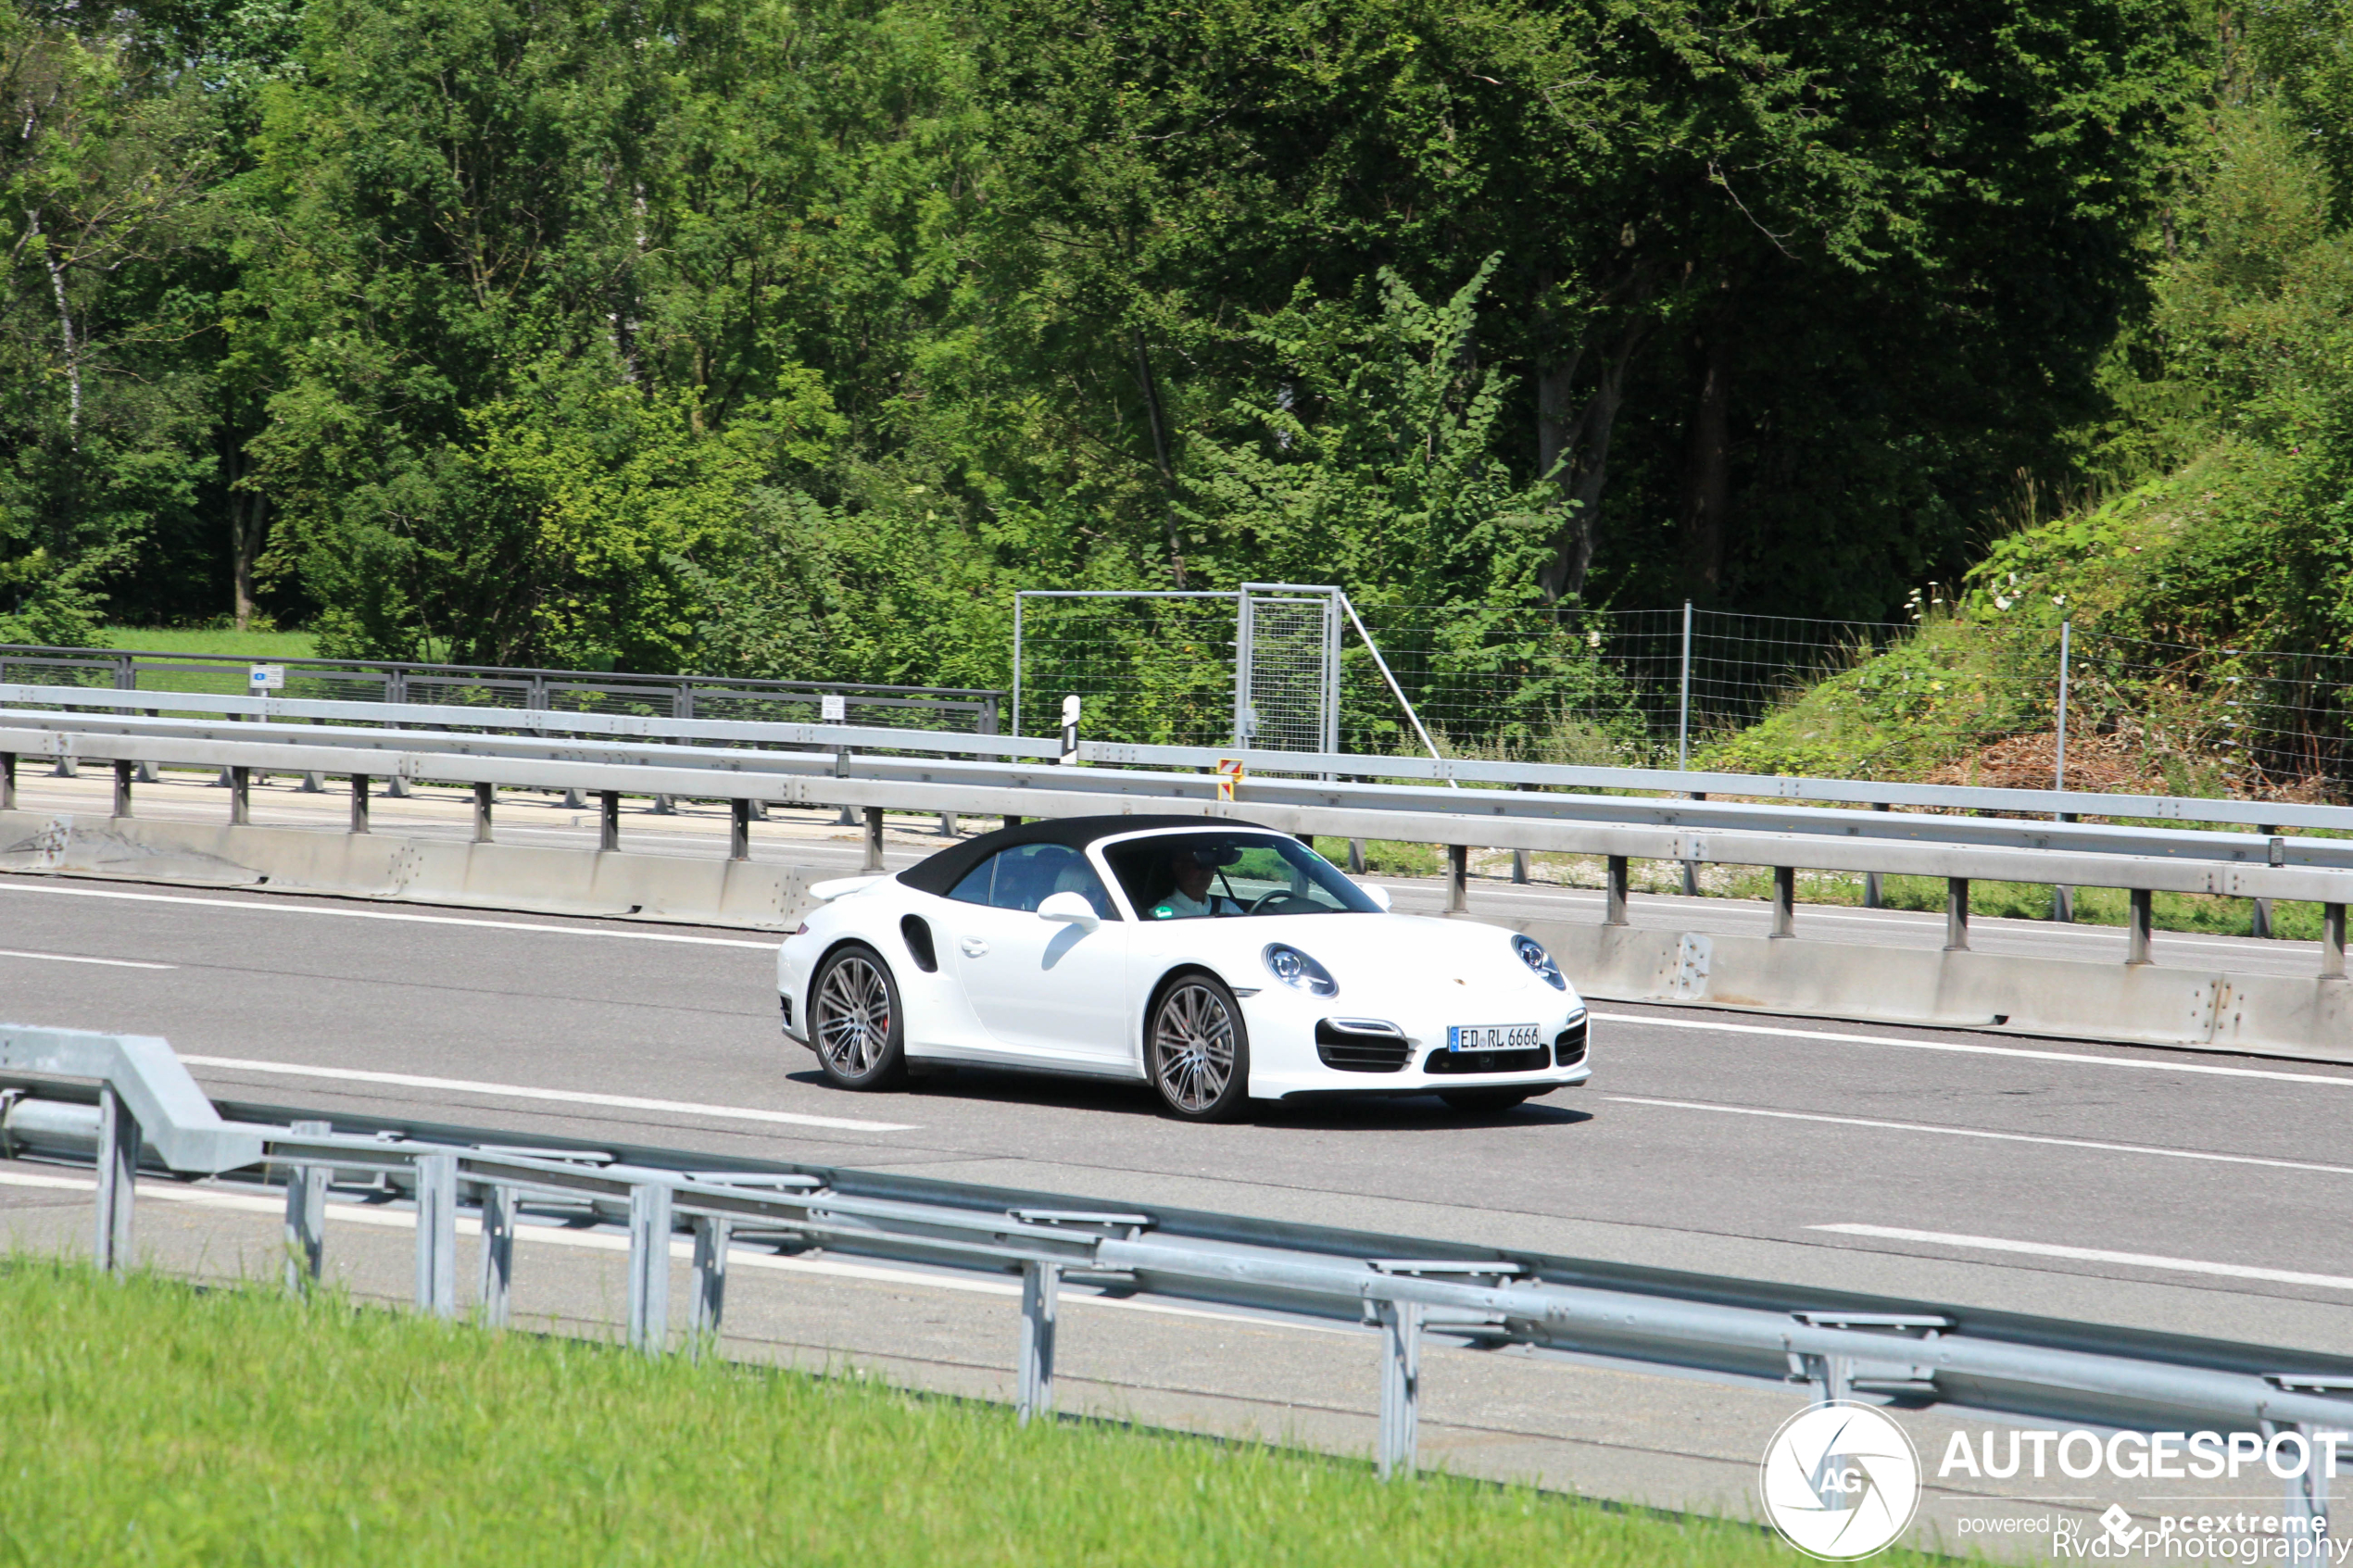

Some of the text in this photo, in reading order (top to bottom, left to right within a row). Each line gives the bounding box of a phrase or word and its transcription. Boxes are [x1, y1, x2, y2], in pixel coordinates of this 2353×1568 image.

[1461, 1028, 1538, 1048] ED RL 6666
